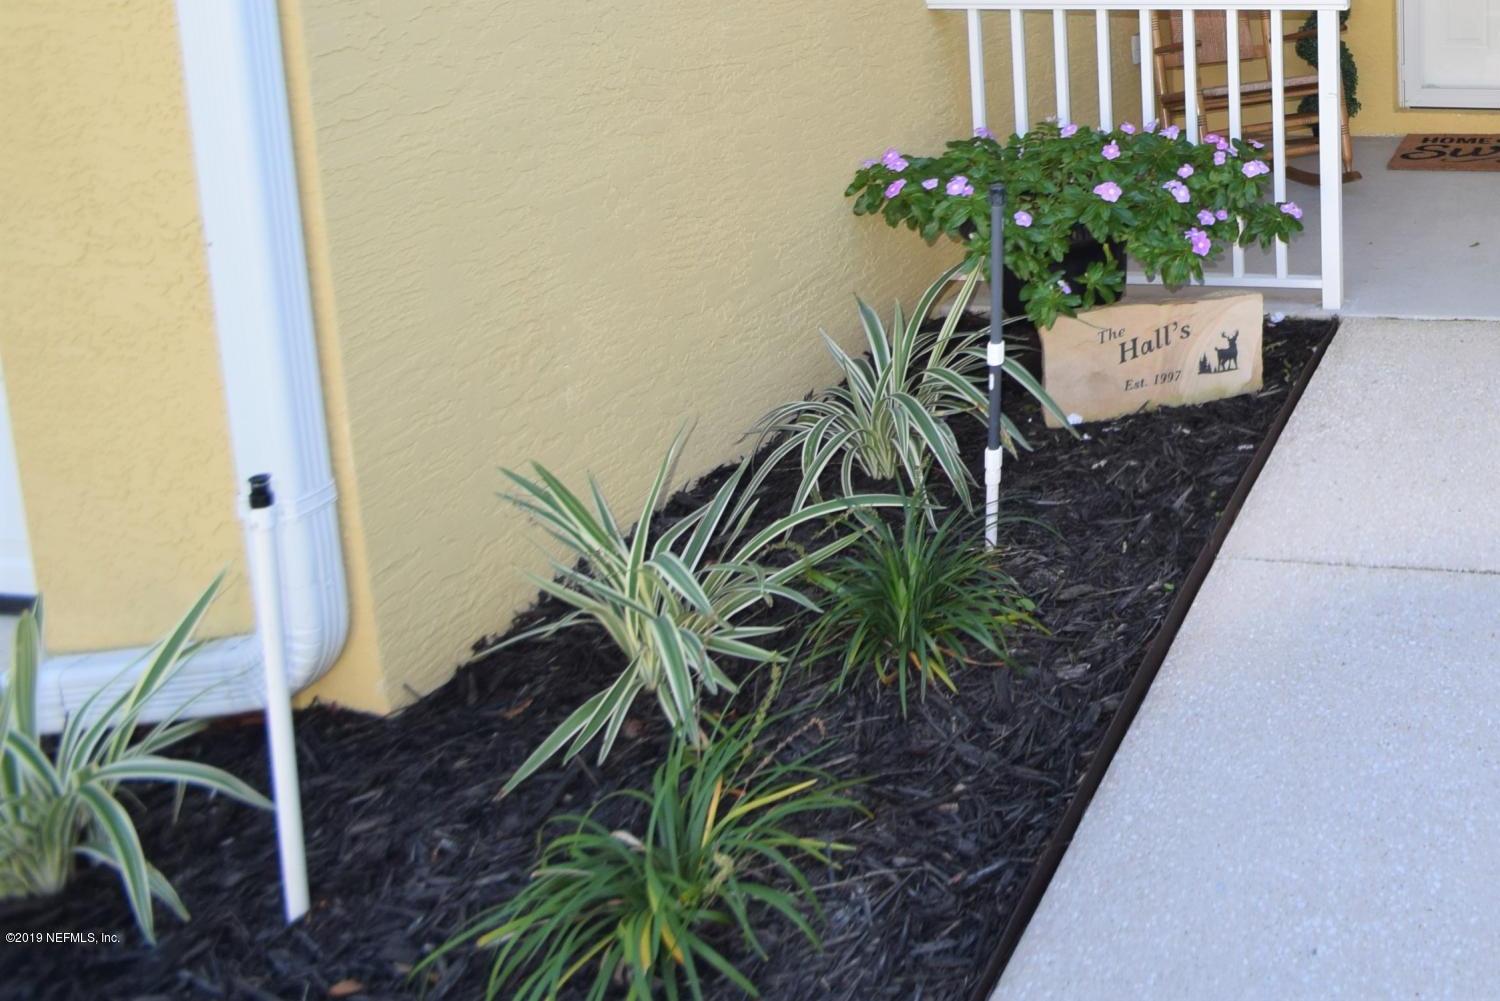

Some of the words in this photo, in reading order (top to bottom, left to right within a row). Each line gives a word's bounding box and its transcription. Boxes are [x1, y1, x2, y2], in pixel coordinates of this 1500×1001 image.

[1097, 328, 1125, 344] The
[1119, 321, 1191, 364] Hall's
[1124, 378, 1148, 391] Est.
[1153, 371, 1181, 385] 1997
